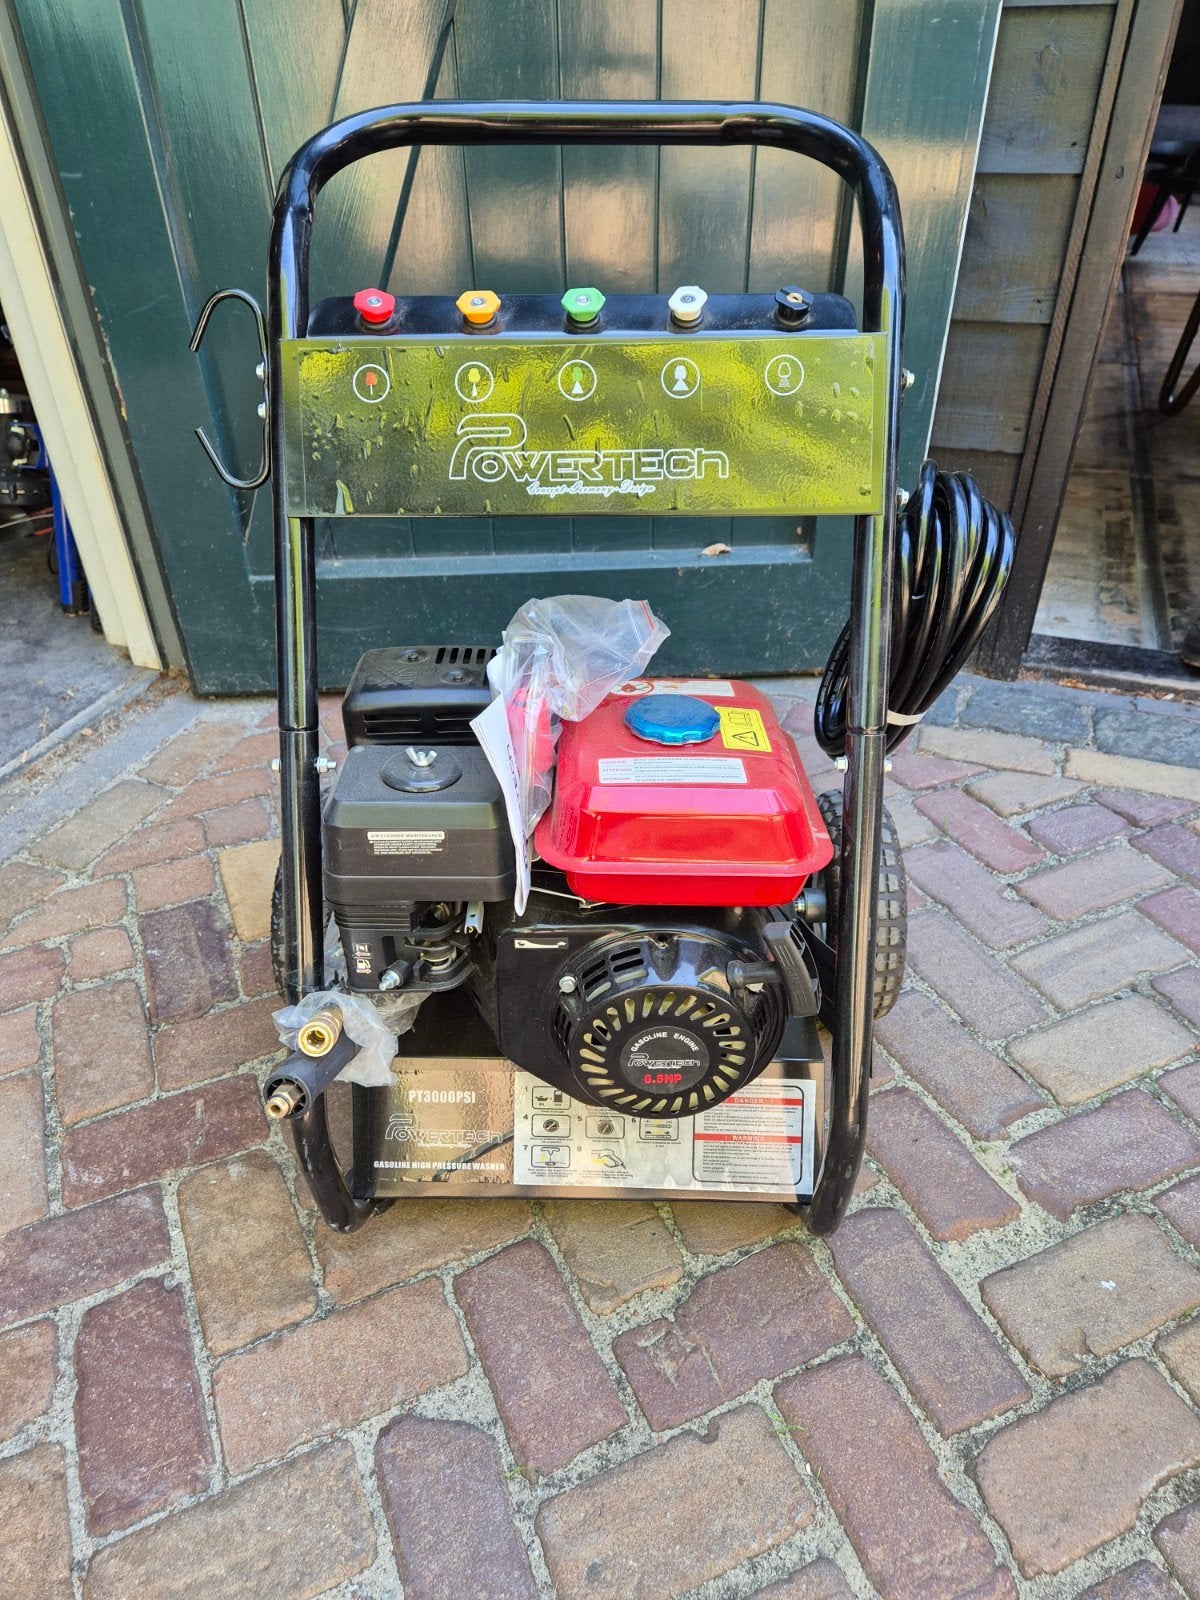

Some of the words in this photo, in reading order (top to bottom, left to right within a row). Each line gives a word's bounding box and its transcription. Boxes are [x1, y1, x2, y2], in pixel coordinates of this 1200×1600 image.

[630, 1031, 668, 1052] GASOLINE
[673, 1032, 700, 1052] ENGINE
[643, 1073, 683, 1084] 6.5HP
[408, 1090, 476, 1104] PT3000PSI
[373, 1161, 411, 1169] GASOLINE
[411, 1161, 431, 1169] HIGH
[432, 1161, 471, 1170] PRESSURE
[472, 1162, 505, 1170] WASHER
